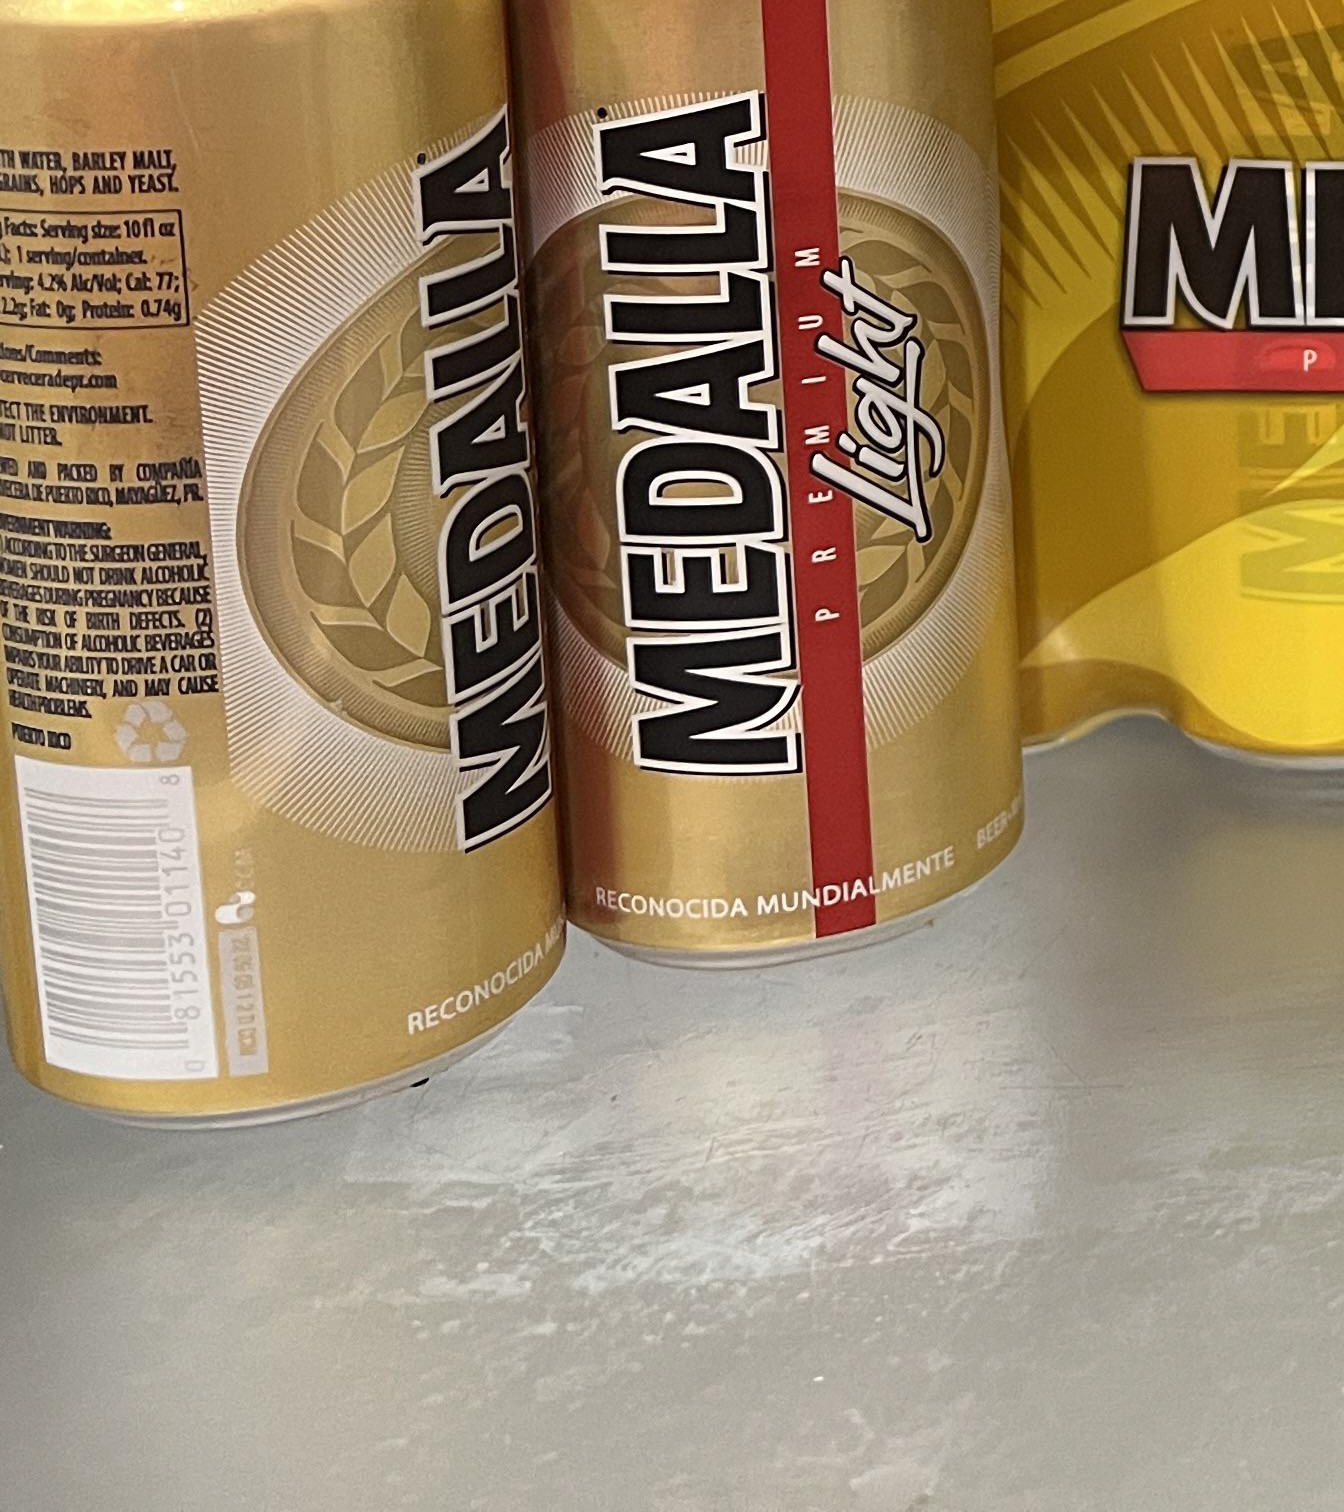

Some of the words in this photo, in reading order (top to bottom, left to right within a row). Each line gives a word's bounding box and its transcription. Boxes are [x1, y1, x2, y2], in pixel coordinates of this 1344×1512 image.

[0, 149, 15, 169] TH
[72, 150, 127, 171] BARLEY
[50, 174, 86, 195] HOPS
[92, 175, 122, 194] AND
[40, 218, 89, 243] Serving
[124, 219, 141, 238] 10
[159, 222, 176, 237] oz
[140, 299, 182, 322] 0.74g
[0, 400, 21, 419] TECT
[24, 402, 47, 423] THE
[811, 254, 958, 546] Light
[594, 91, 804, 777] MEDALLA
[795, 247, 839, 623] PREMIUM
[418, 104, 554, 854] MEDALLA
[159, 656, 170, 674] A
[170, 654, 196, 673] CAR
[198, 653, 218, 672] OR
[595, 886, 749, 919] RECONOCIDA
[756, 845, 956, 917] MUNDIALMENTE
[407, 942, 545, 1036] RECONOCIDA
